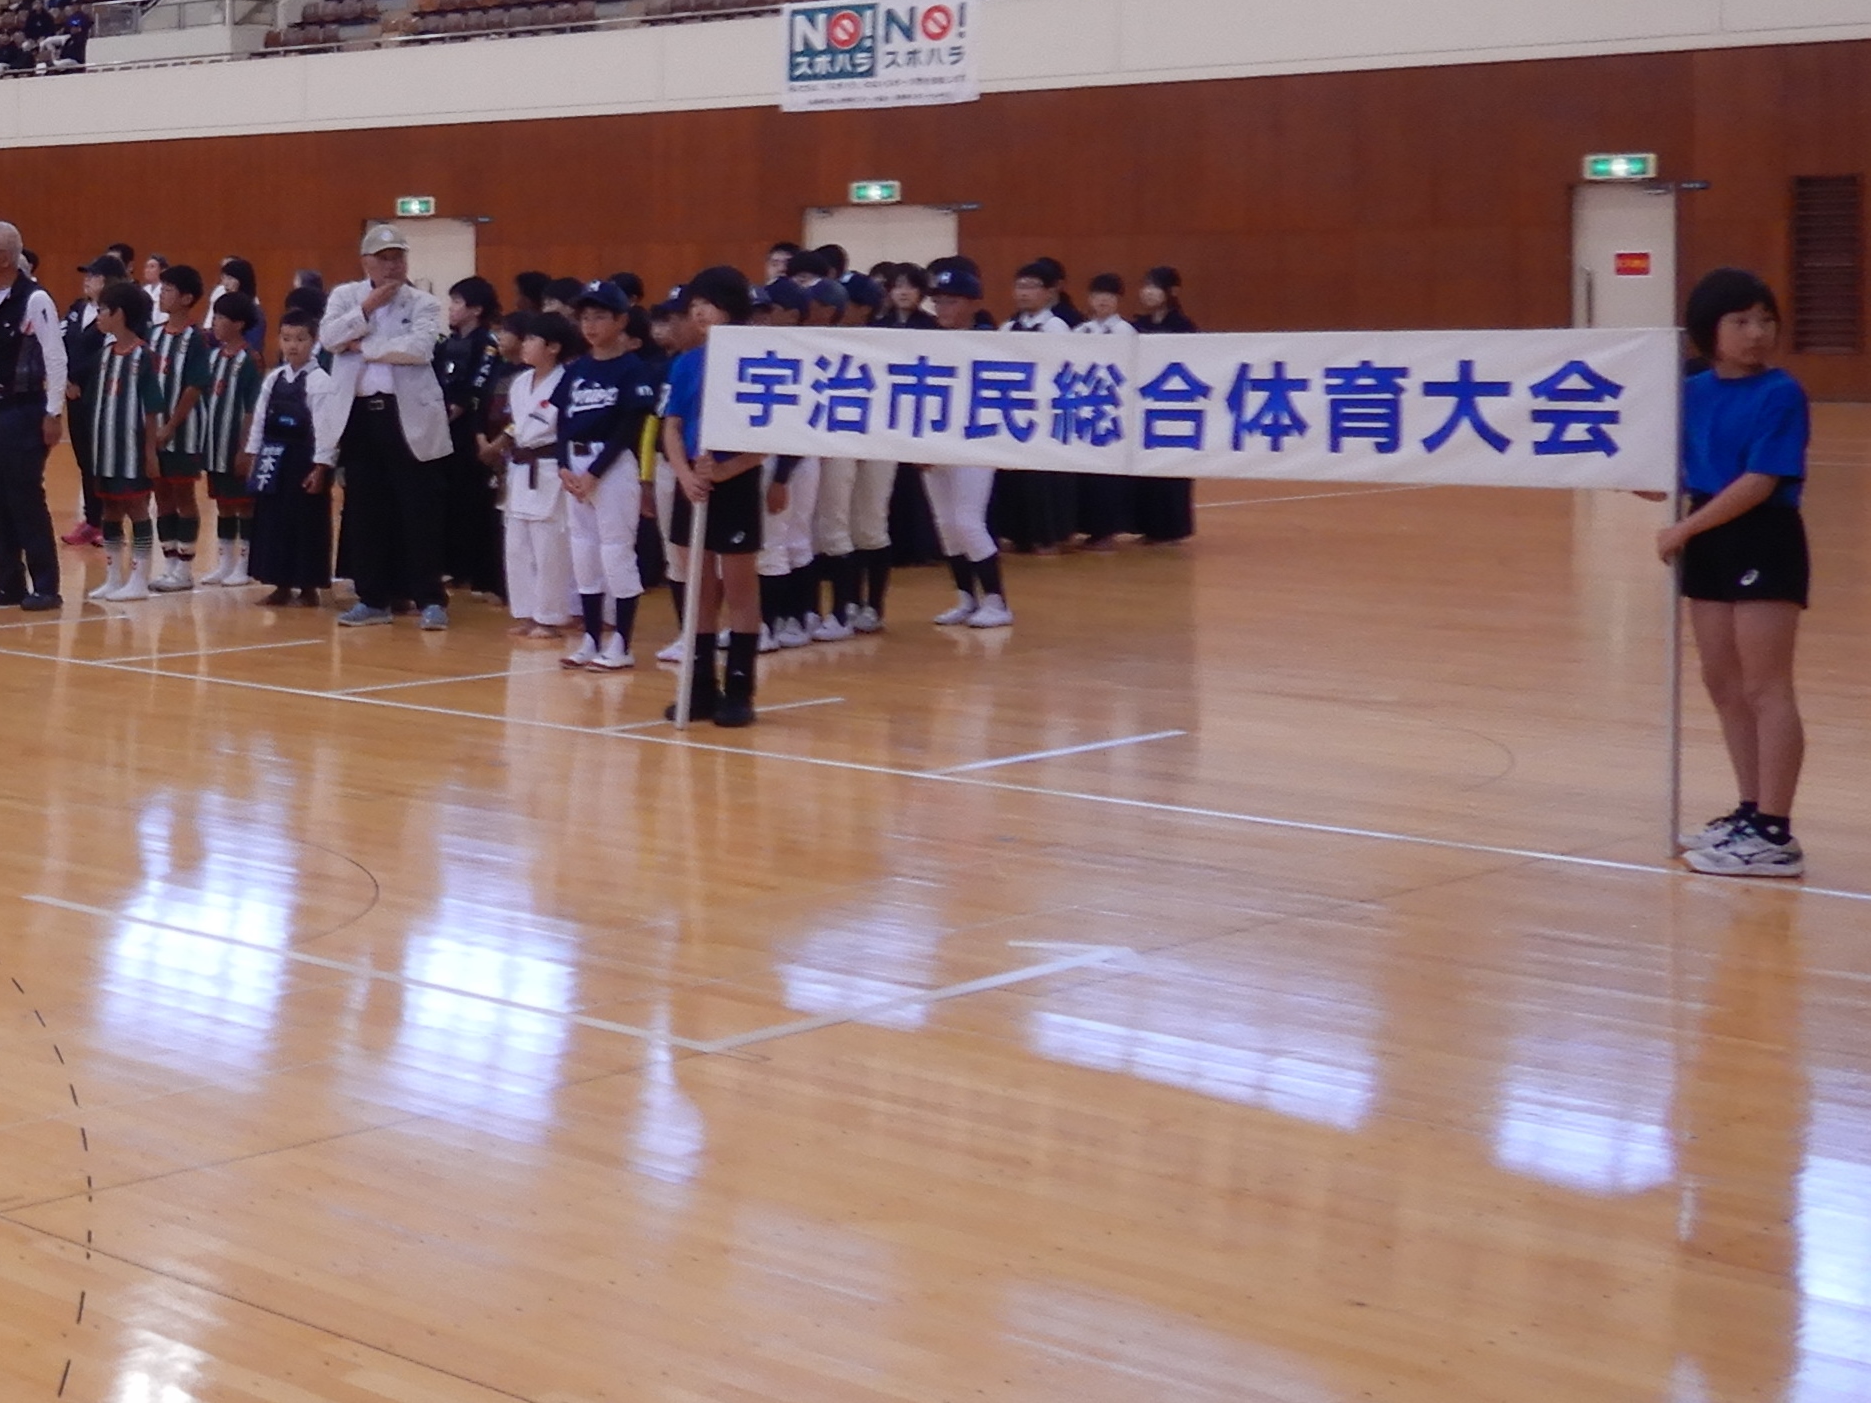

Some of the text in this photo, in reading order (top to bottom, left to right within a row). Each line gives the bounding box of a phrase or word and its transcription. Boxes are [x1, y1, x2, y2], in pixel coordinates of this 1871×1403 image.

[793, 52, 874, 77] スポハラ
[884, 45, 966, 70] スポハラ
[734, 348, 1626, 459] 宇治市民総合体育大会
